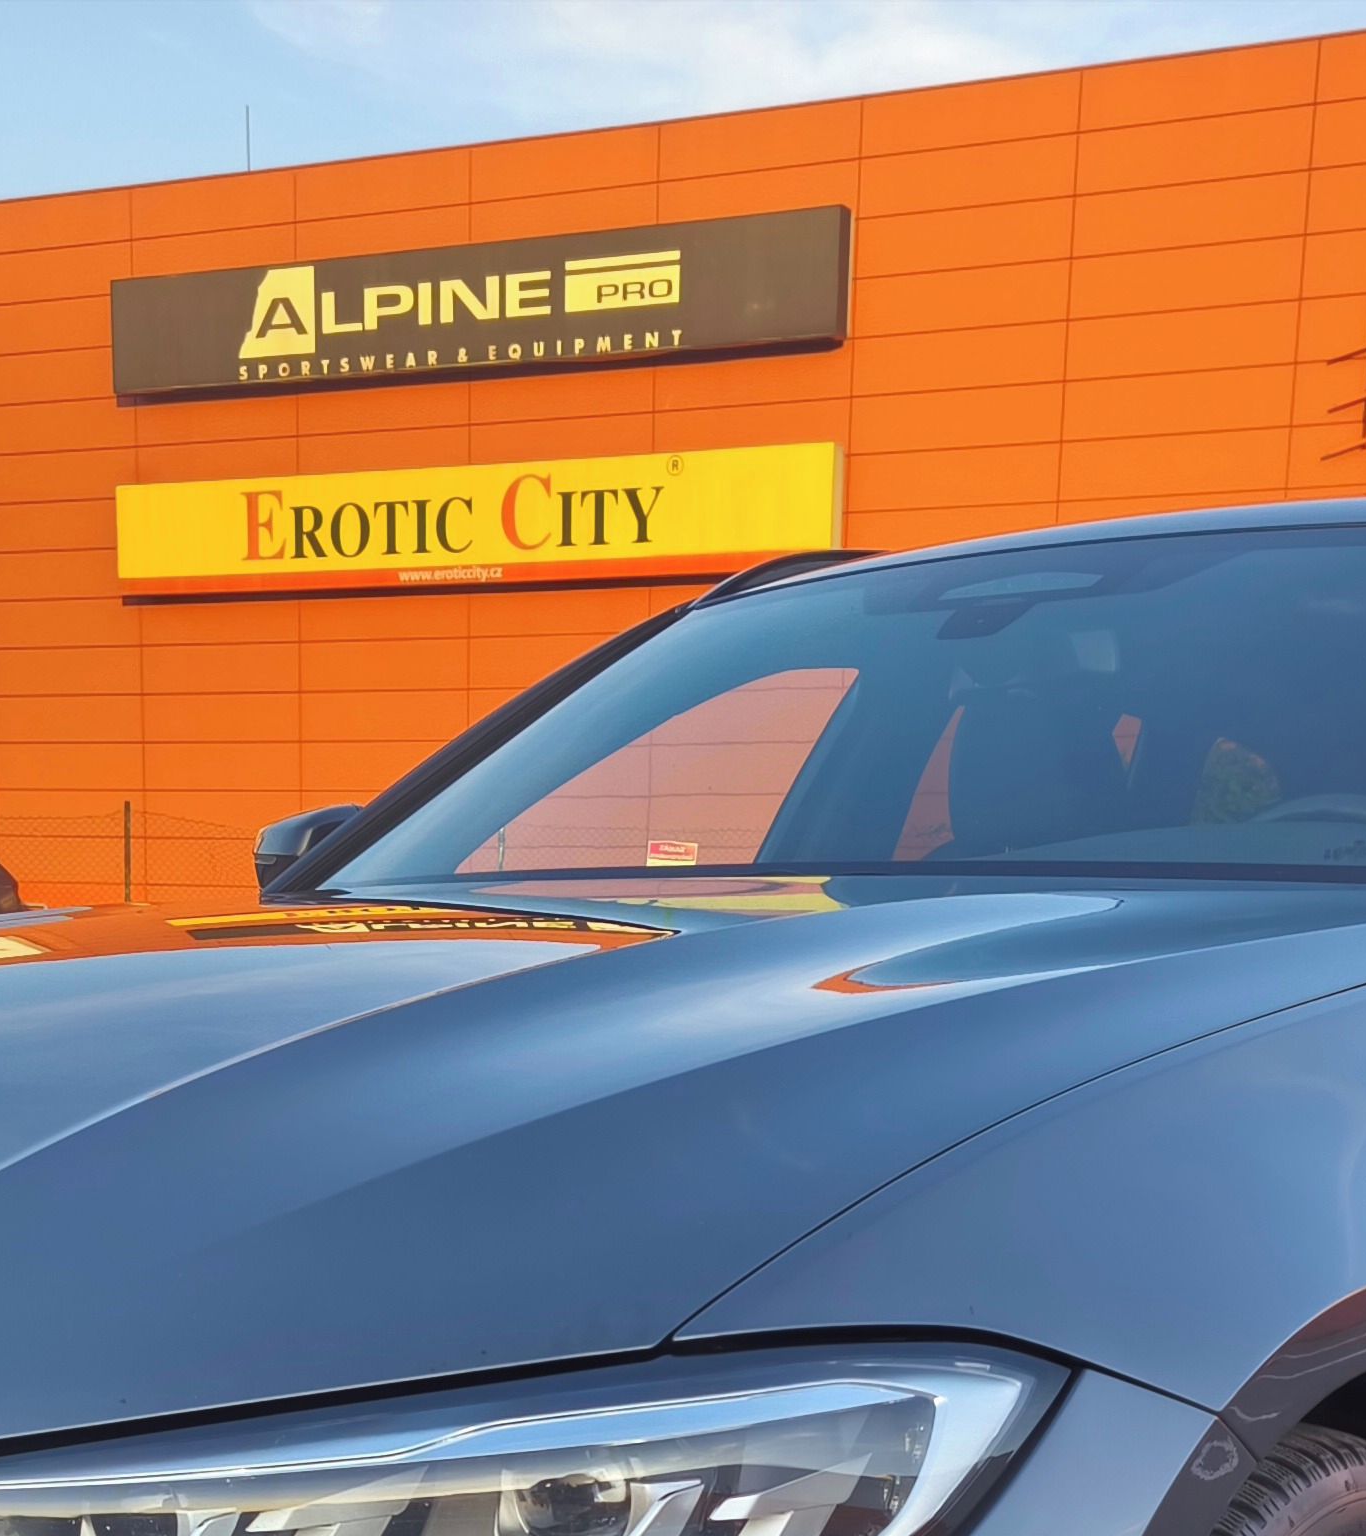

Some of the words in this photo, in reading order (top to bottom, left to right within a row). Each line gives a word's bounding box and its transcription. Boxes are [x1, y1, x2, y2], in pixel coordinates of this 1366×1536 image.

[239, 265, 552, 358] ALPINE
[596, 278, 673, 304] PRO
[237, 350, 439, 381] SPORTSWEAR
[457, 347, 469, 362] &
[488, 329, 683, 361] EQUIPMENT
[240, 488, 474, 562] EROTIC
[500, 473, 665, 551] CITY
[398, 566, 503, 583] www.eroticcity.cz
